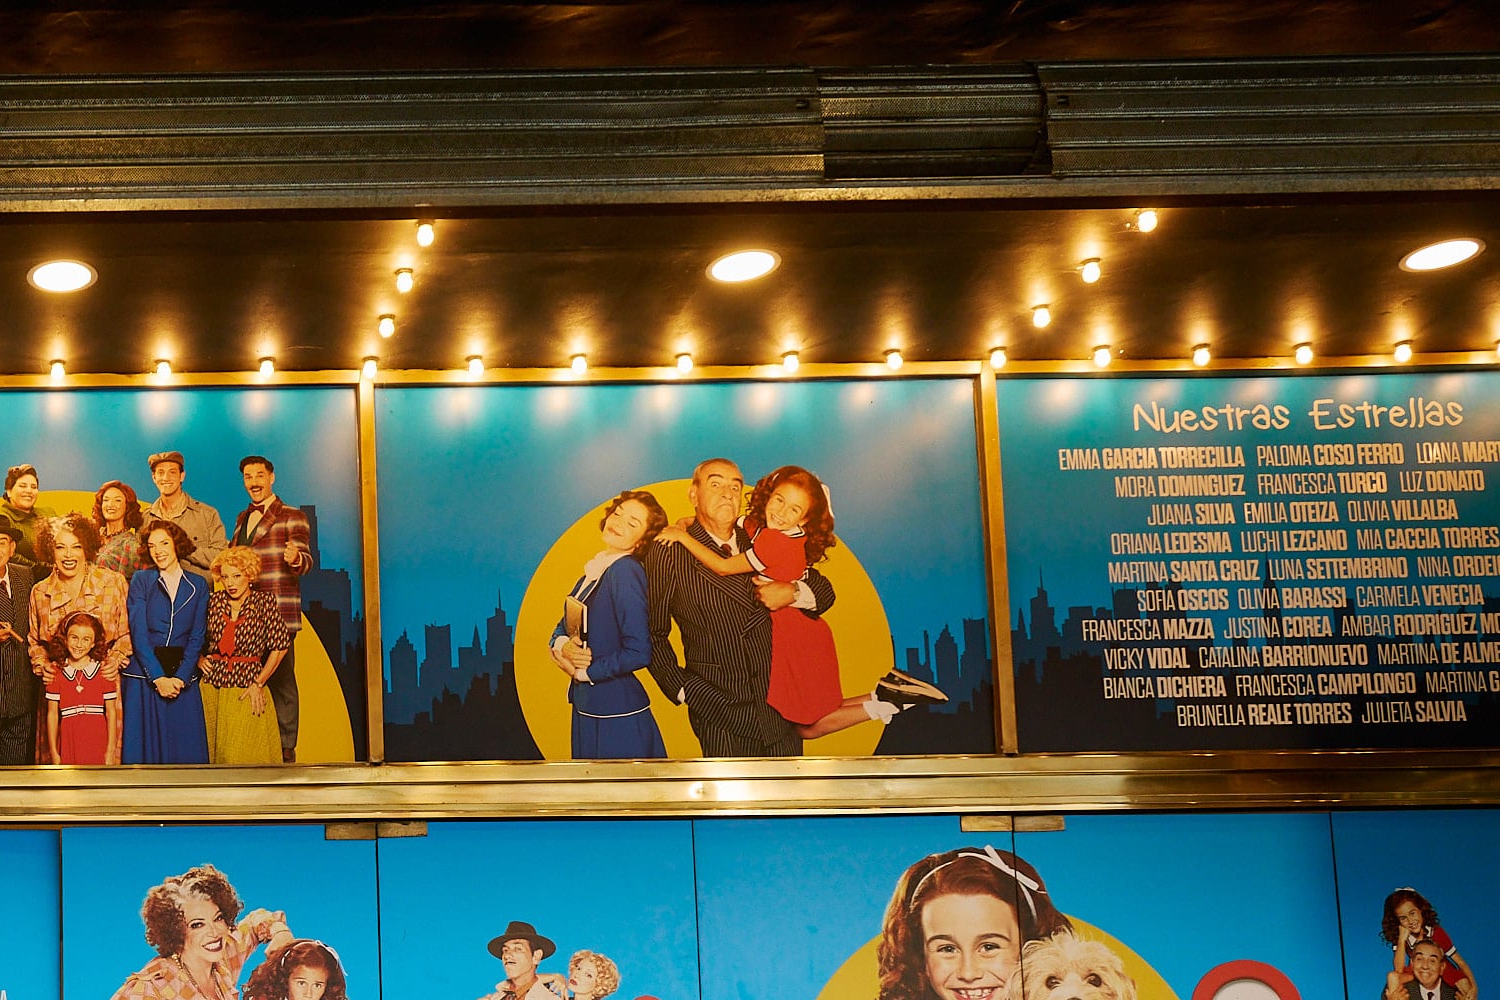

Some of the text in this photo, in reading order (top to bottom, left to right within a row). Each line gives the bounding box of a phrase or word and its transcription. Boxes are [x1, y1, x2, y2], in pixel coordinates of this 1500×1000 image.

[1133, 397, 1464, 433] Nuestras Estrellas
[1058, 441, 1461, 470] EMMA GARCIA TORRECILLA PALOMA COSO FERRO LOANA
[1115, 469, 1485, 498] MORA DOMINGUEZ FRANCESCA TURCO LUZ DONATO
[1147, 499, 1459, 526] JUANA SILVA EMILIA OTEIZA OLIVIA VILLALBA
[1110, 526, 1500, 555] ORIANA LEDESMA LUCHI LEZCANO MIA CACCIA TORRES
[1108, 555, 1451, 583] MARTINA SANTA CRUZ LUNA SETTEMBRINO NINA
[1137, 584, 1485, 612] SOFIA OSCOS OLIVIA BARASSI CARMELA VENECIA
[1082, 619, 1162, 642] FRANCESCA
[1163, 618, 1215, 640] MAZZA
[1223, 616, 1280, 639] JUSTINA
[1282, 615, 1333, 638] COREA
[1341, 614, 1392, 637] AMBAR
[1104, 642, 1460, 670] VICKY VIDAL CATALINA BARRIONUEVO MARTINA DE
[1103, 671, 1488, 699] BIANCA DICHIERA FRANCESCA CAMPILONGO MARTINA
[1177, 700, 1467, 727] BRUNELLA REALE TORRES JULIETA SALVIA
